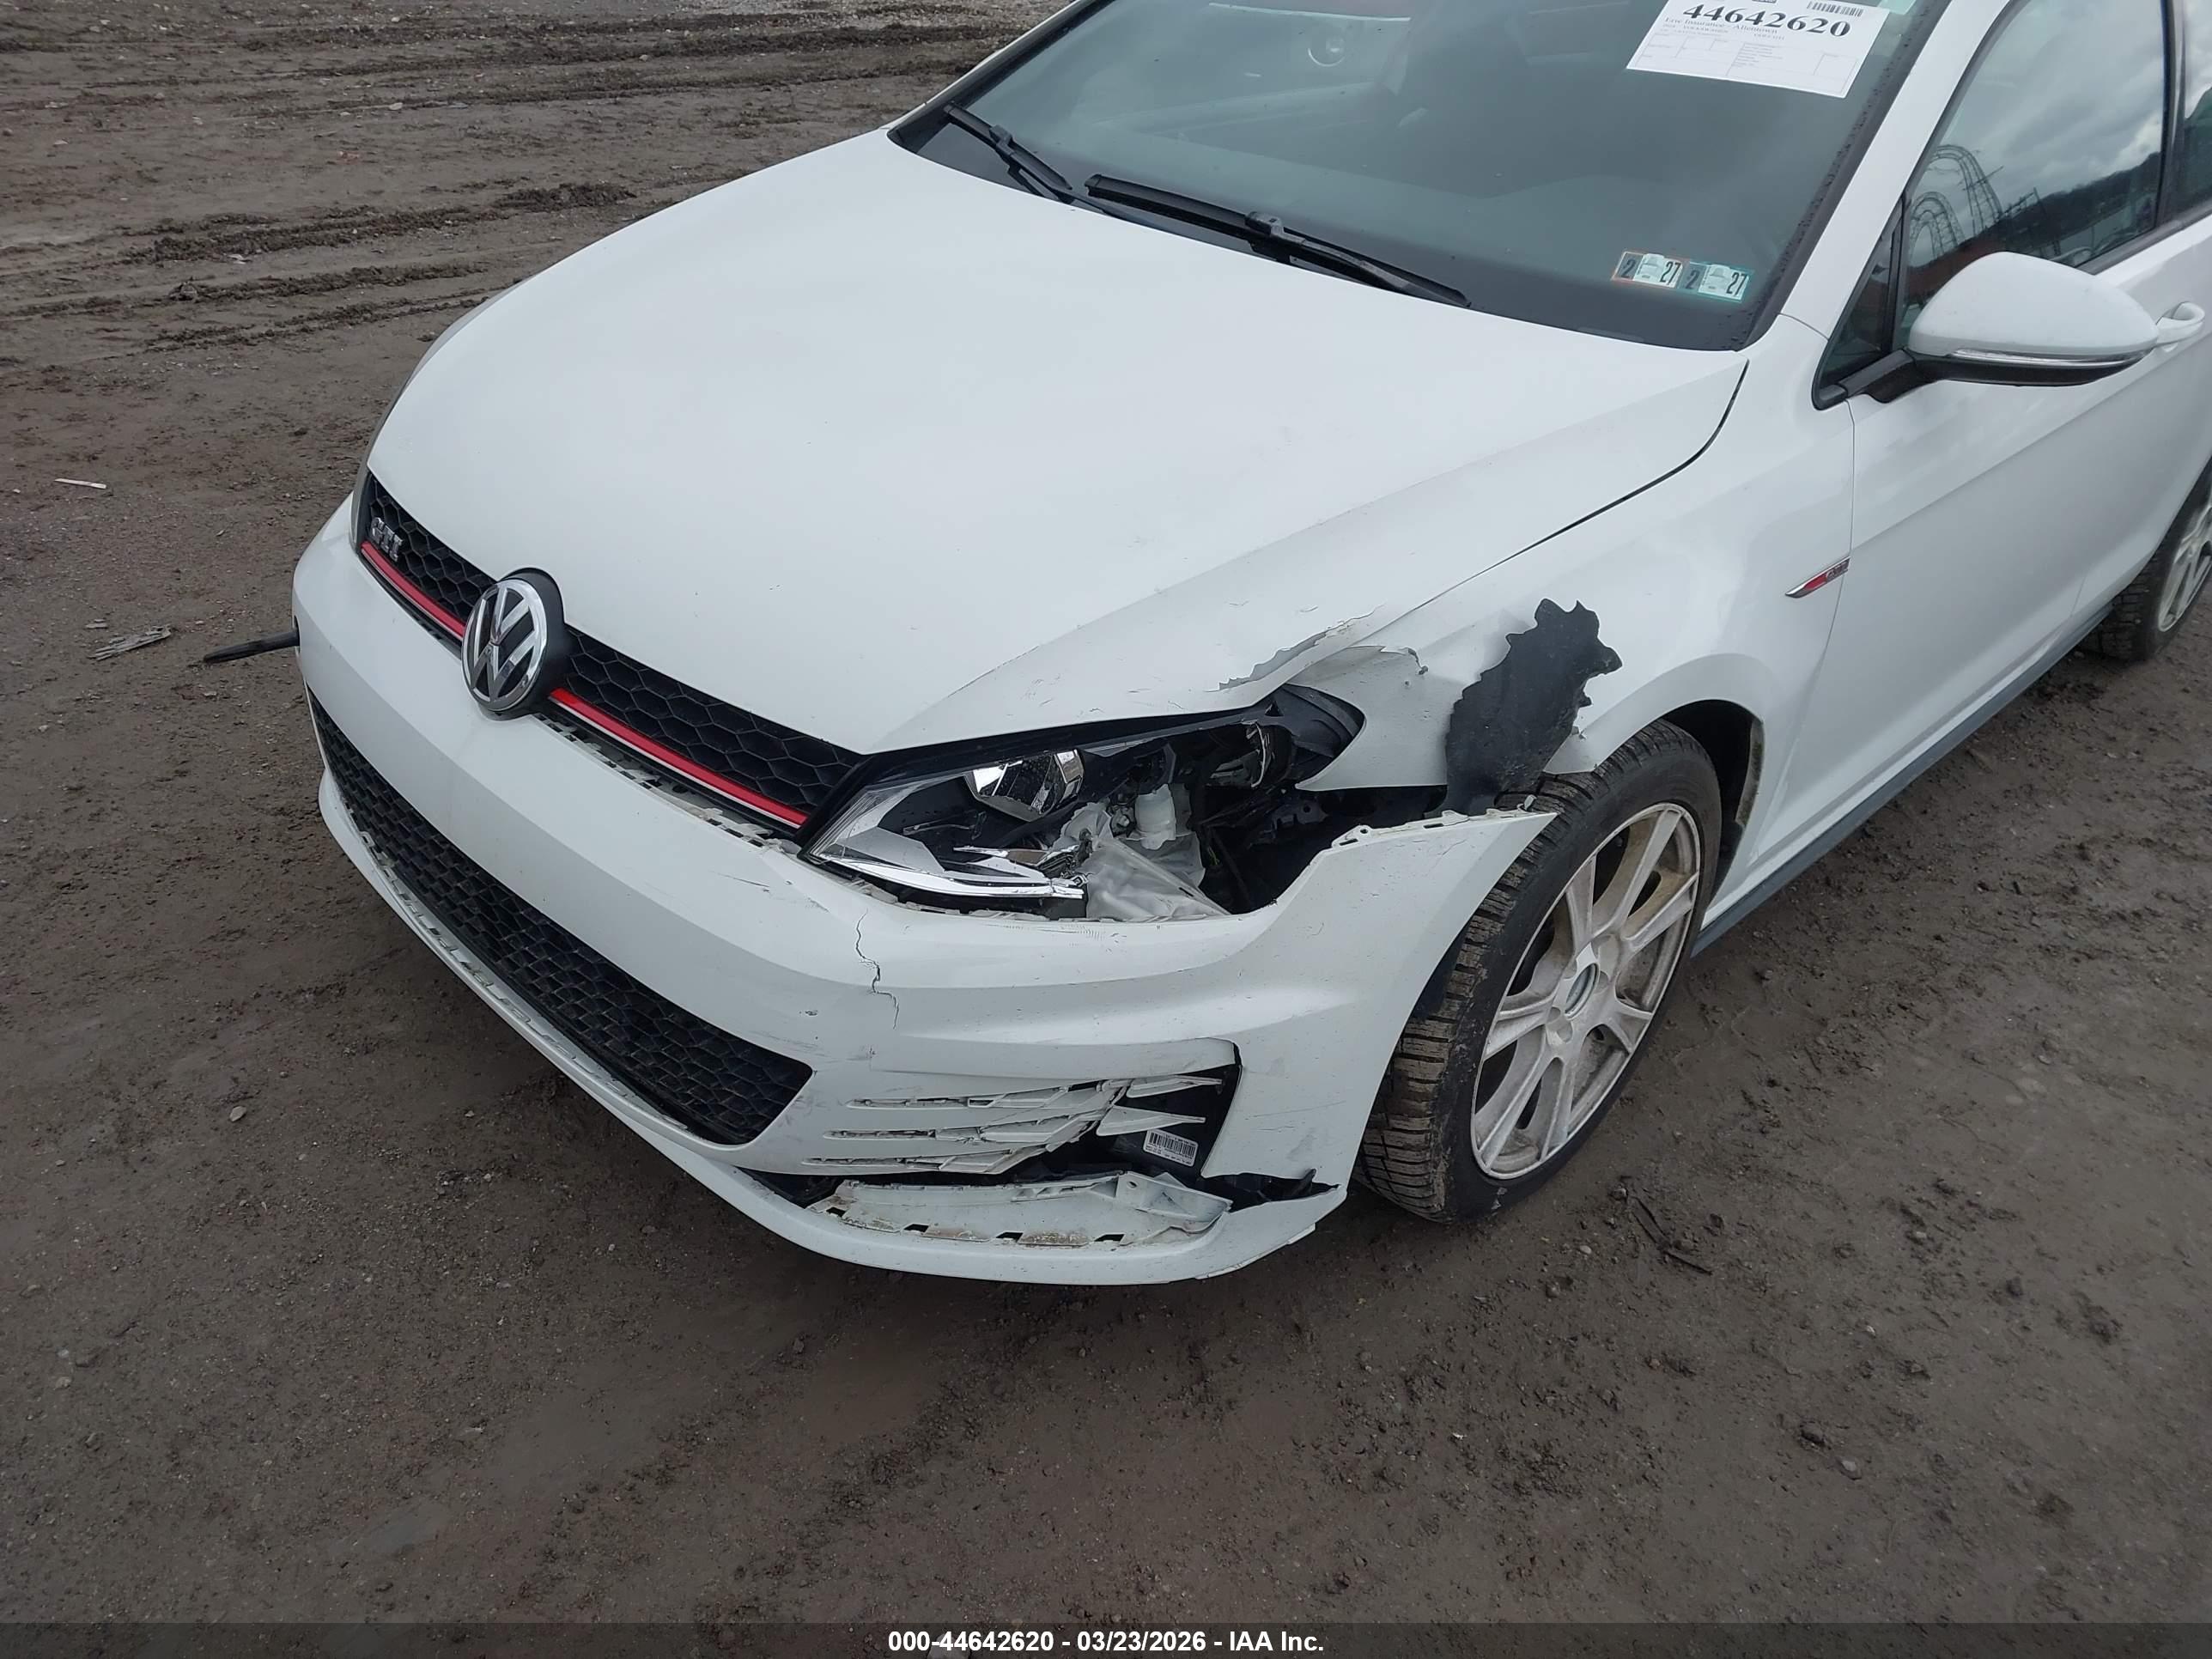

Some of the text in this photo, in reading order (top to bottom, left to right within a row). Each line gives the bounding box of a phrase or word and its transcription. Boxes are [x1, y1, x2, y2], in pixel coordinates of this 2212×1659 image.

[1682, 3, 1850, 37] 44642620
[1684, 19, 1725, 27] Insurance
[1732, 24, 1778, 34] Allentown
[1621, 258, 1637, 279] 2
[1660, 261, 1682, 285] 27
[1686, 270, 1701, 289] 2
[1726, 272, 1747, 296] 27
